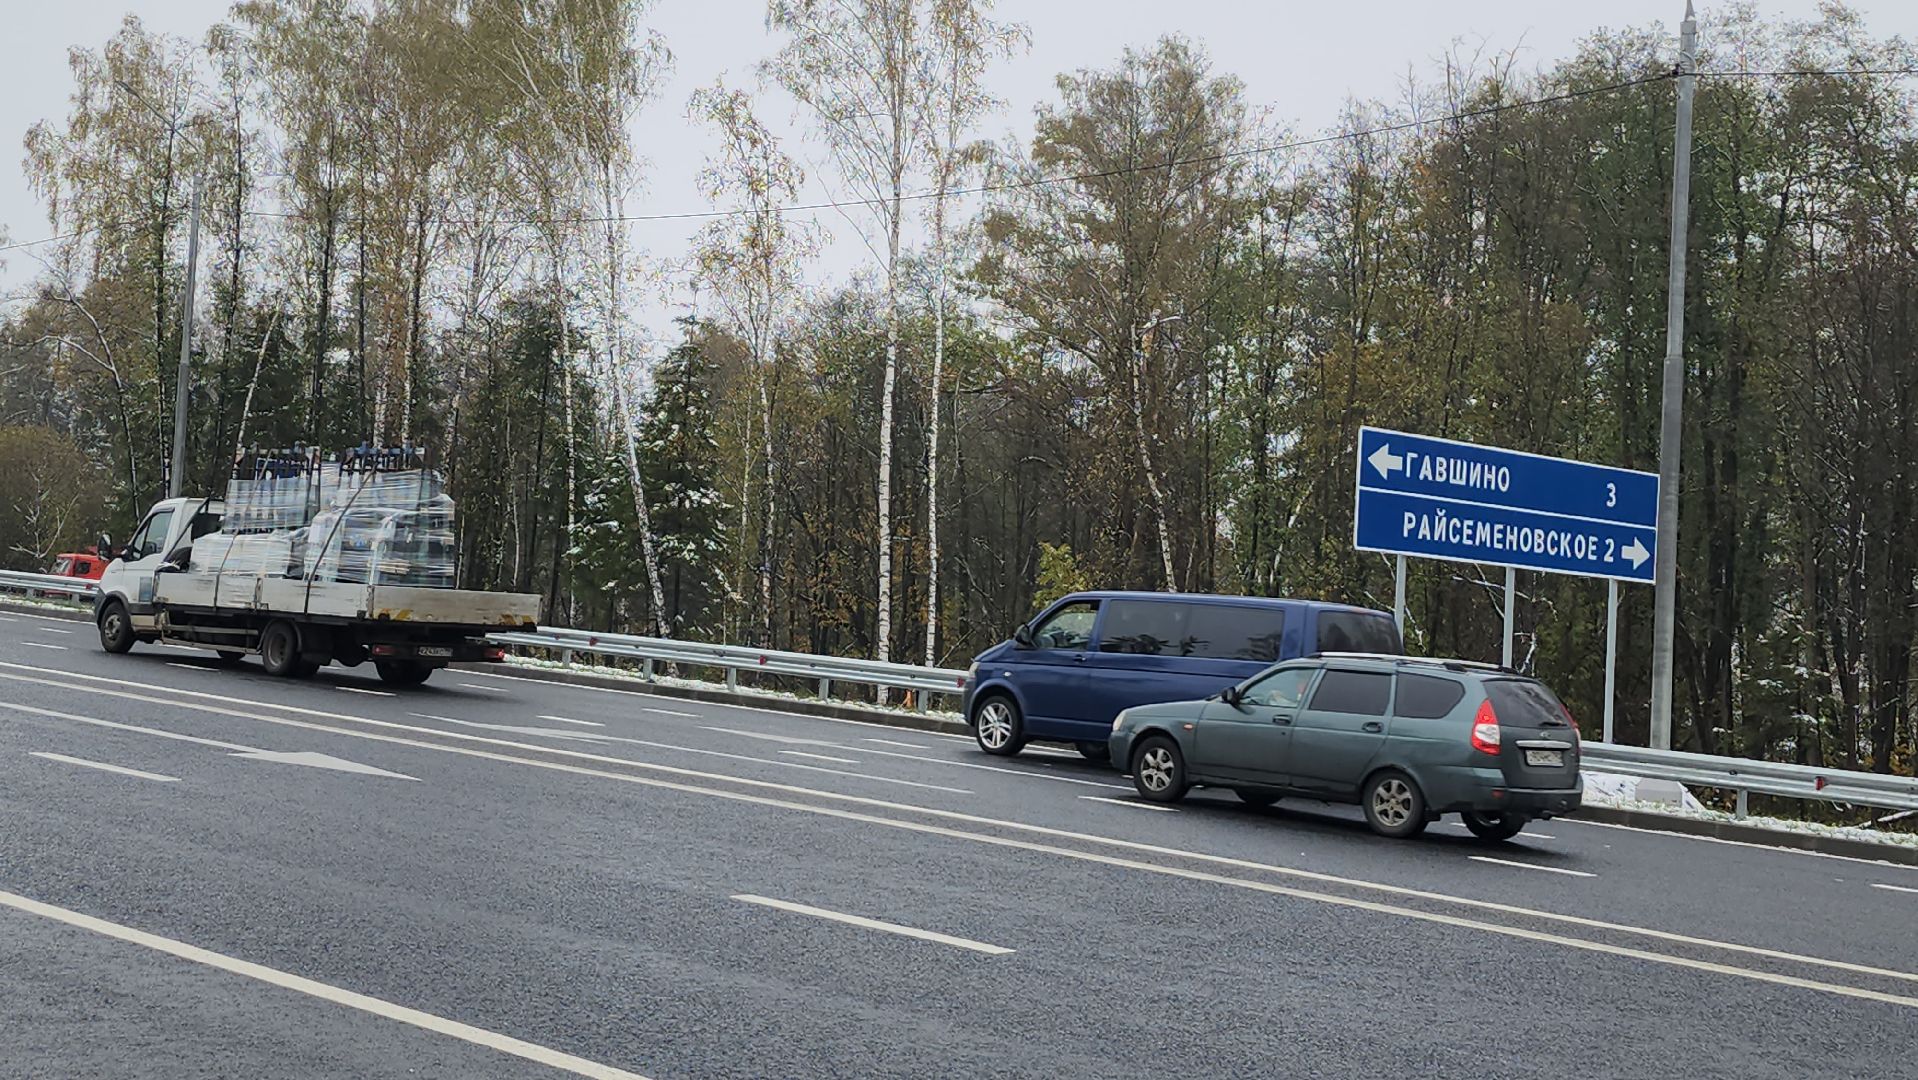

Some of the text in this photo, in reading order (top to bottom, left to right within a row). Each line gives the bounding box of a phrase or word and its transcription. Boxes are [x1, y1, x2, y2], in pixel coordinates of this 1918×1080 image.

[1404, 452, 1616, 507] ГАВШИНО 3
[1403, 508, 1615, 563] РАЙСЕМЕНОВСКОЕ 2
